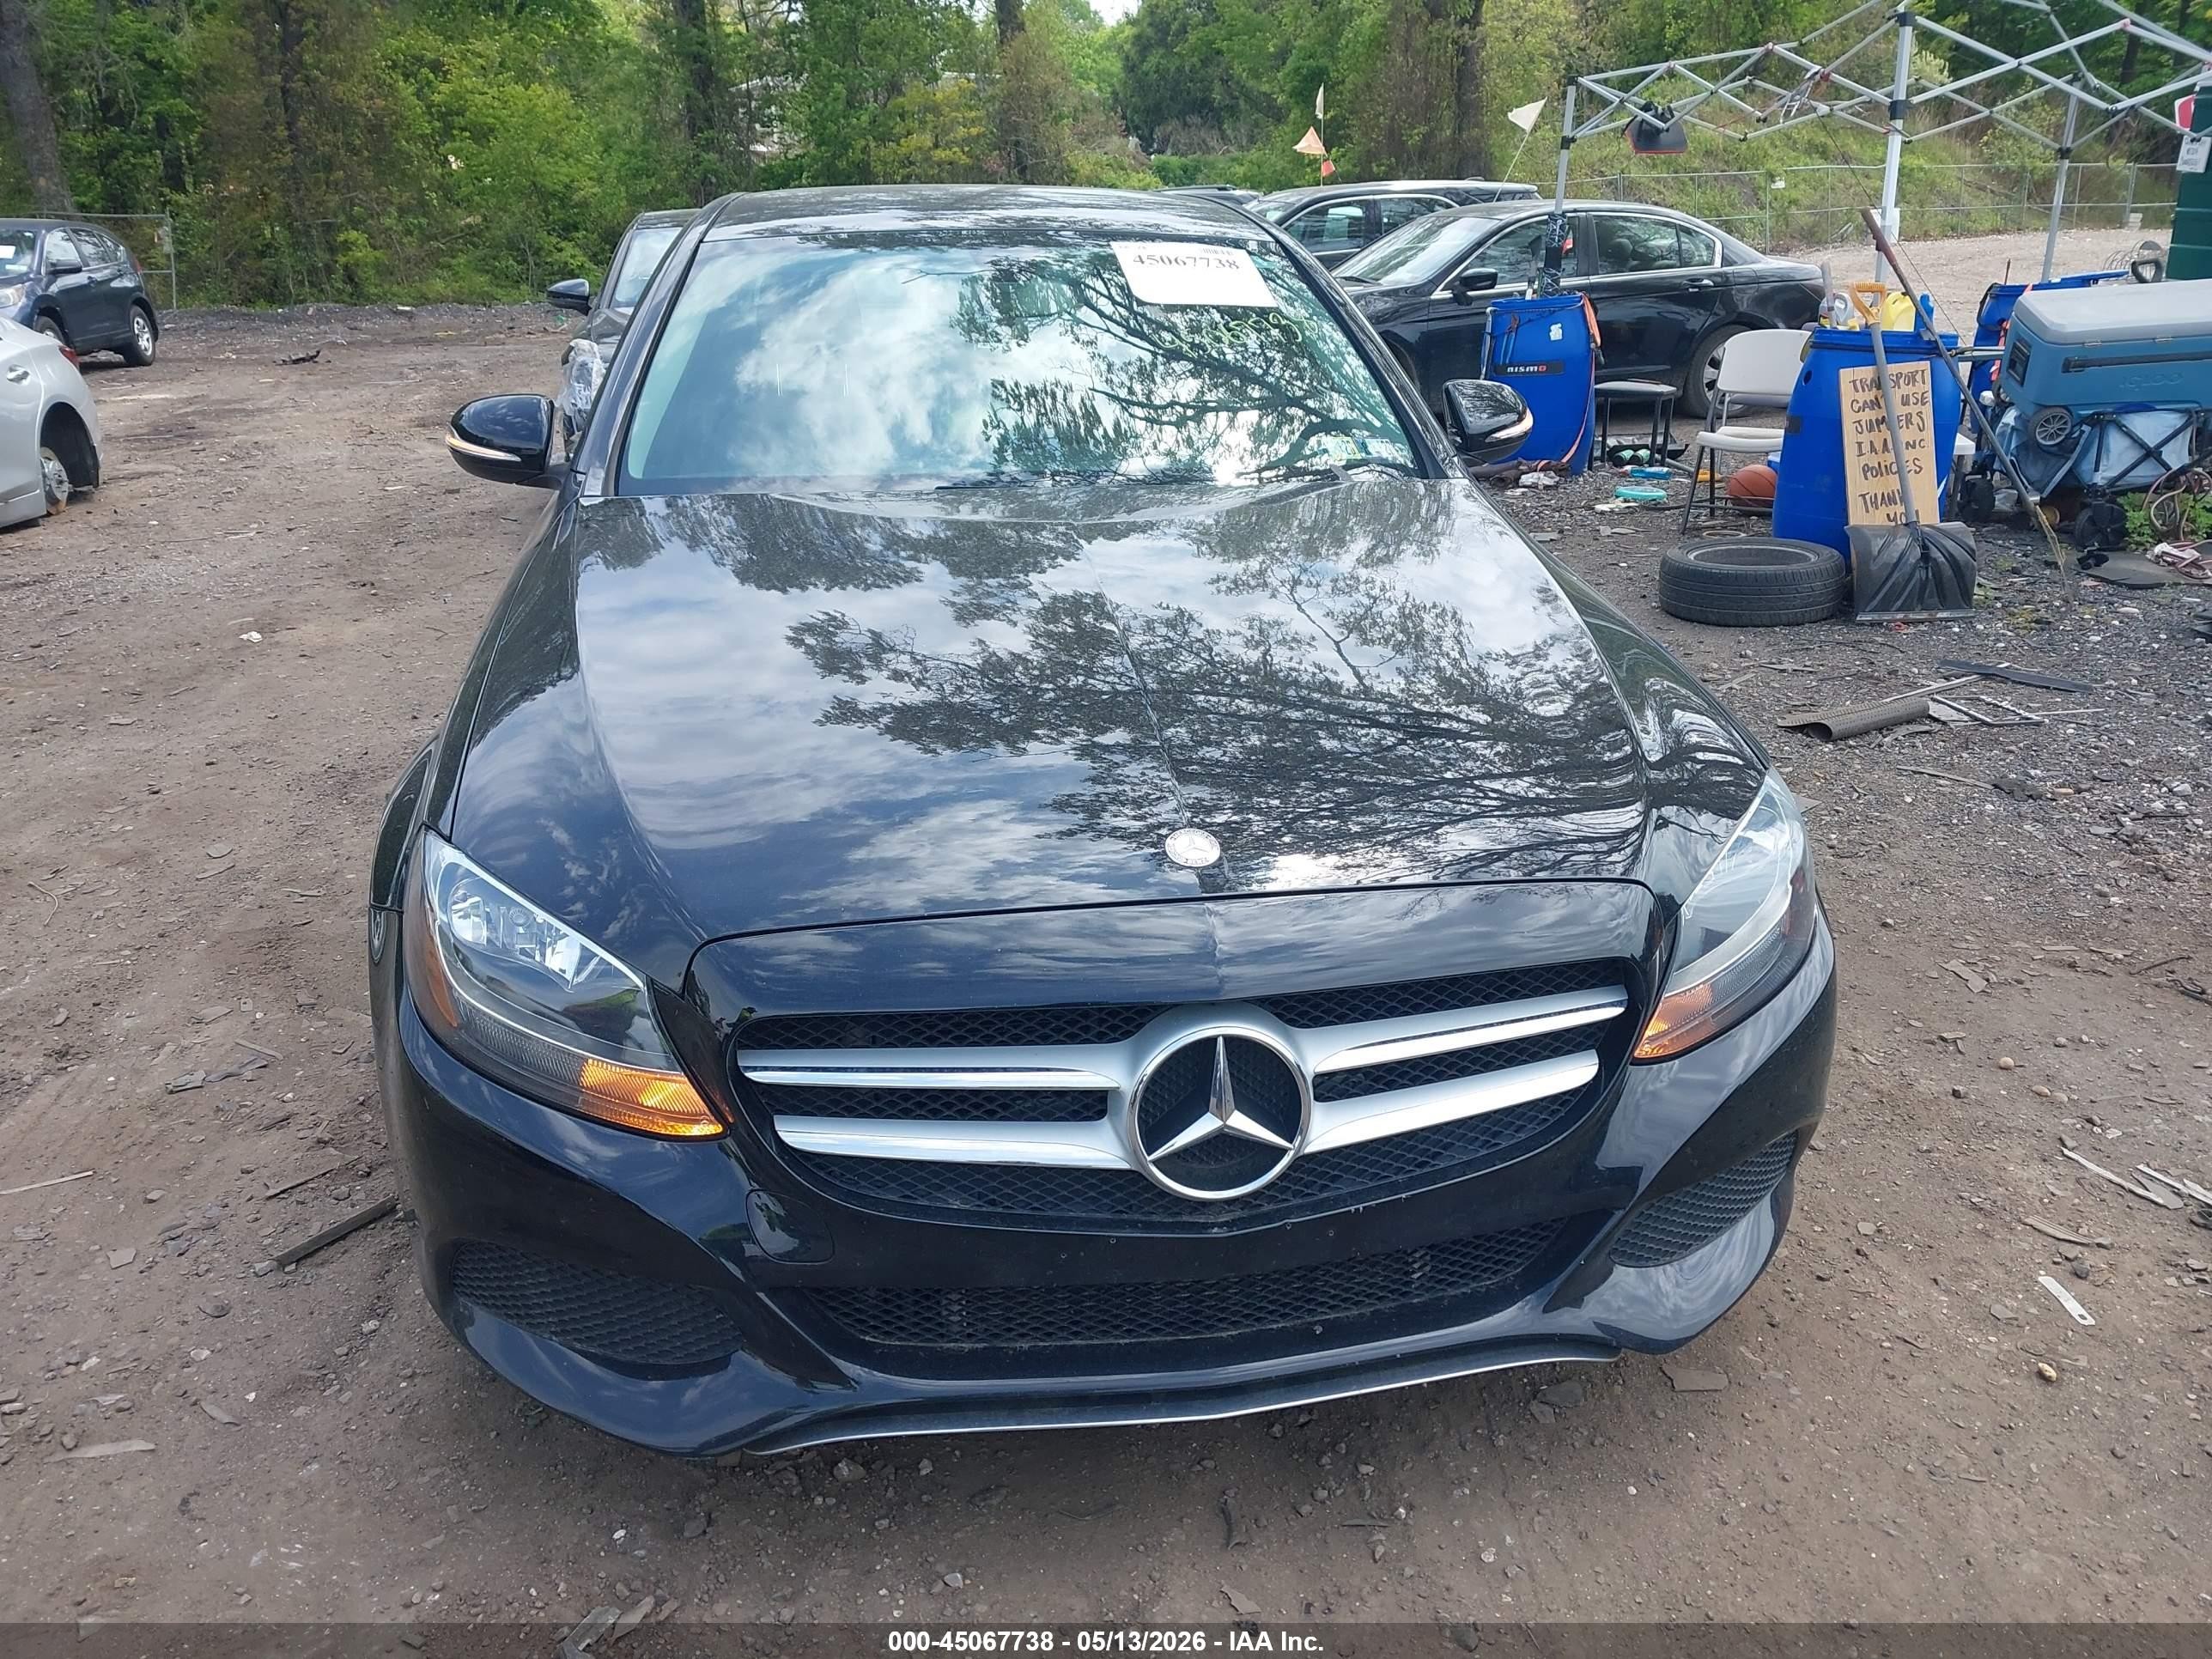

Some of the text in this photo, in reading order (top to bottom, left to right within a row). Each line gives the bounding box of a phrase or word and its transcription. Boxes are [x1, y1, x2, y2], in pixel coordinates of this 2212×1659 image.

[1133, 254, 1239, 270] 45067738
[1849, 369, 1926, 392] TRASPORT
[1900, 390, 1929, 406] USE
[1852, 410, 1925, 434] JUMERS
